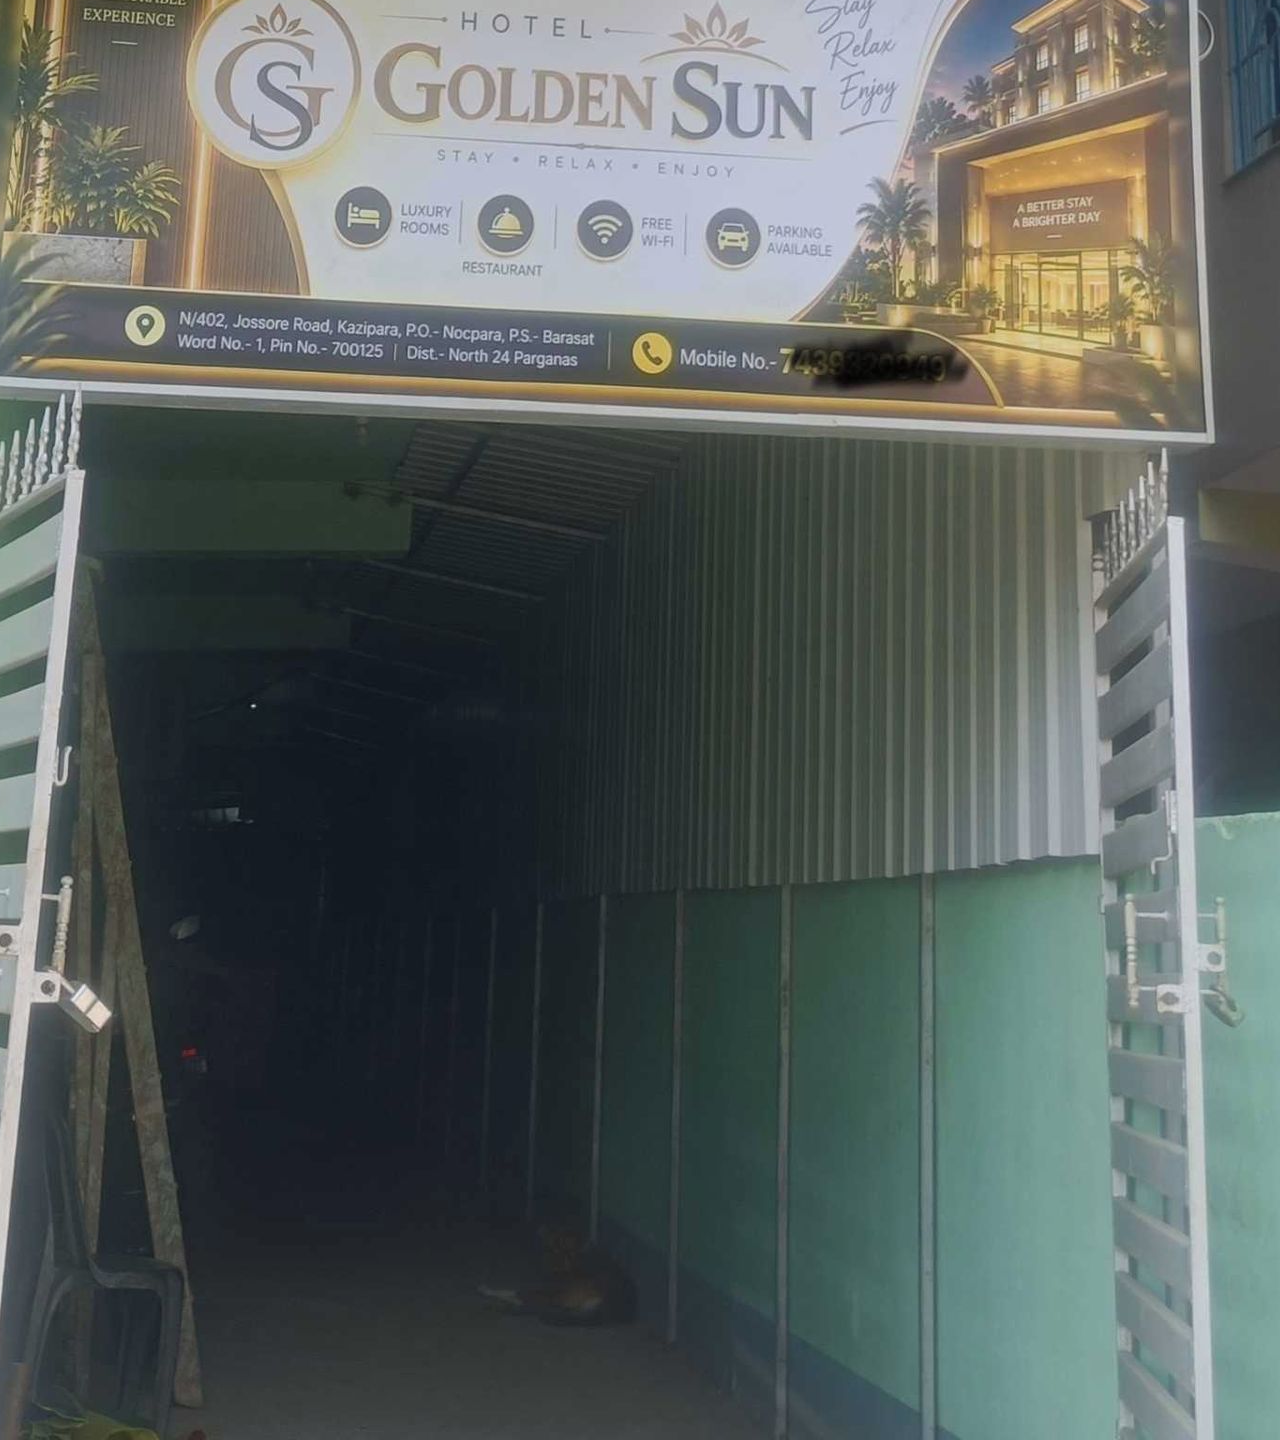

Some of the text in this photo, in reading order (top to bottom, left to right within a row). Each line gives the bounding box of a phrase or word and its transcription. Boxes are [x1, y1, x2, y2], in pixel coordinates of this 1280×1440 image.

[83, 6, 177, 28] EXPERIENCE
[460, 11, 593, 39] HOTEL
[824, 27, 898, 71] Relax
[373, 41, 817, 142] GOLDEN SUN
[840, 69, 901, 116] Enjoy
[436, 148, 736, 178] STAY RELAX ENJOY
[400, 203, 452, 219] LUXURY
[1017, 196, 1094, 214] A BETTER STAY
[400, 220, 450, 236] ROOMS
[641, 217, 673, 231] FREE
[1012, 211, 1102, 229] A BRIGHTER DAY
[641, 234, 674, 248] WI-FI
[768, 224, 823, 240] PARKING
[767, 242, 832, 258] AVAILABLE
[462, 260, 543, 277] RESTAURANT
[179, 311, 228, 330] N/402,
[232, 315, 289, 331] Jossore
[293, 318, 333, 335] Road,
[337, 320, 402, 340] Kazipara,
[542, 330, 595, 346] Barasat
[177, 334, 217, 350] Word
[270, 339, 293, 353] Pin
[331, 342, 384, 359] 700125
[449, 348, 489, 363] North
[491, 350, 510, 365] 24
[513, 351, 578, 369] Parganas
[680, 348, 737, 368] Mobile
